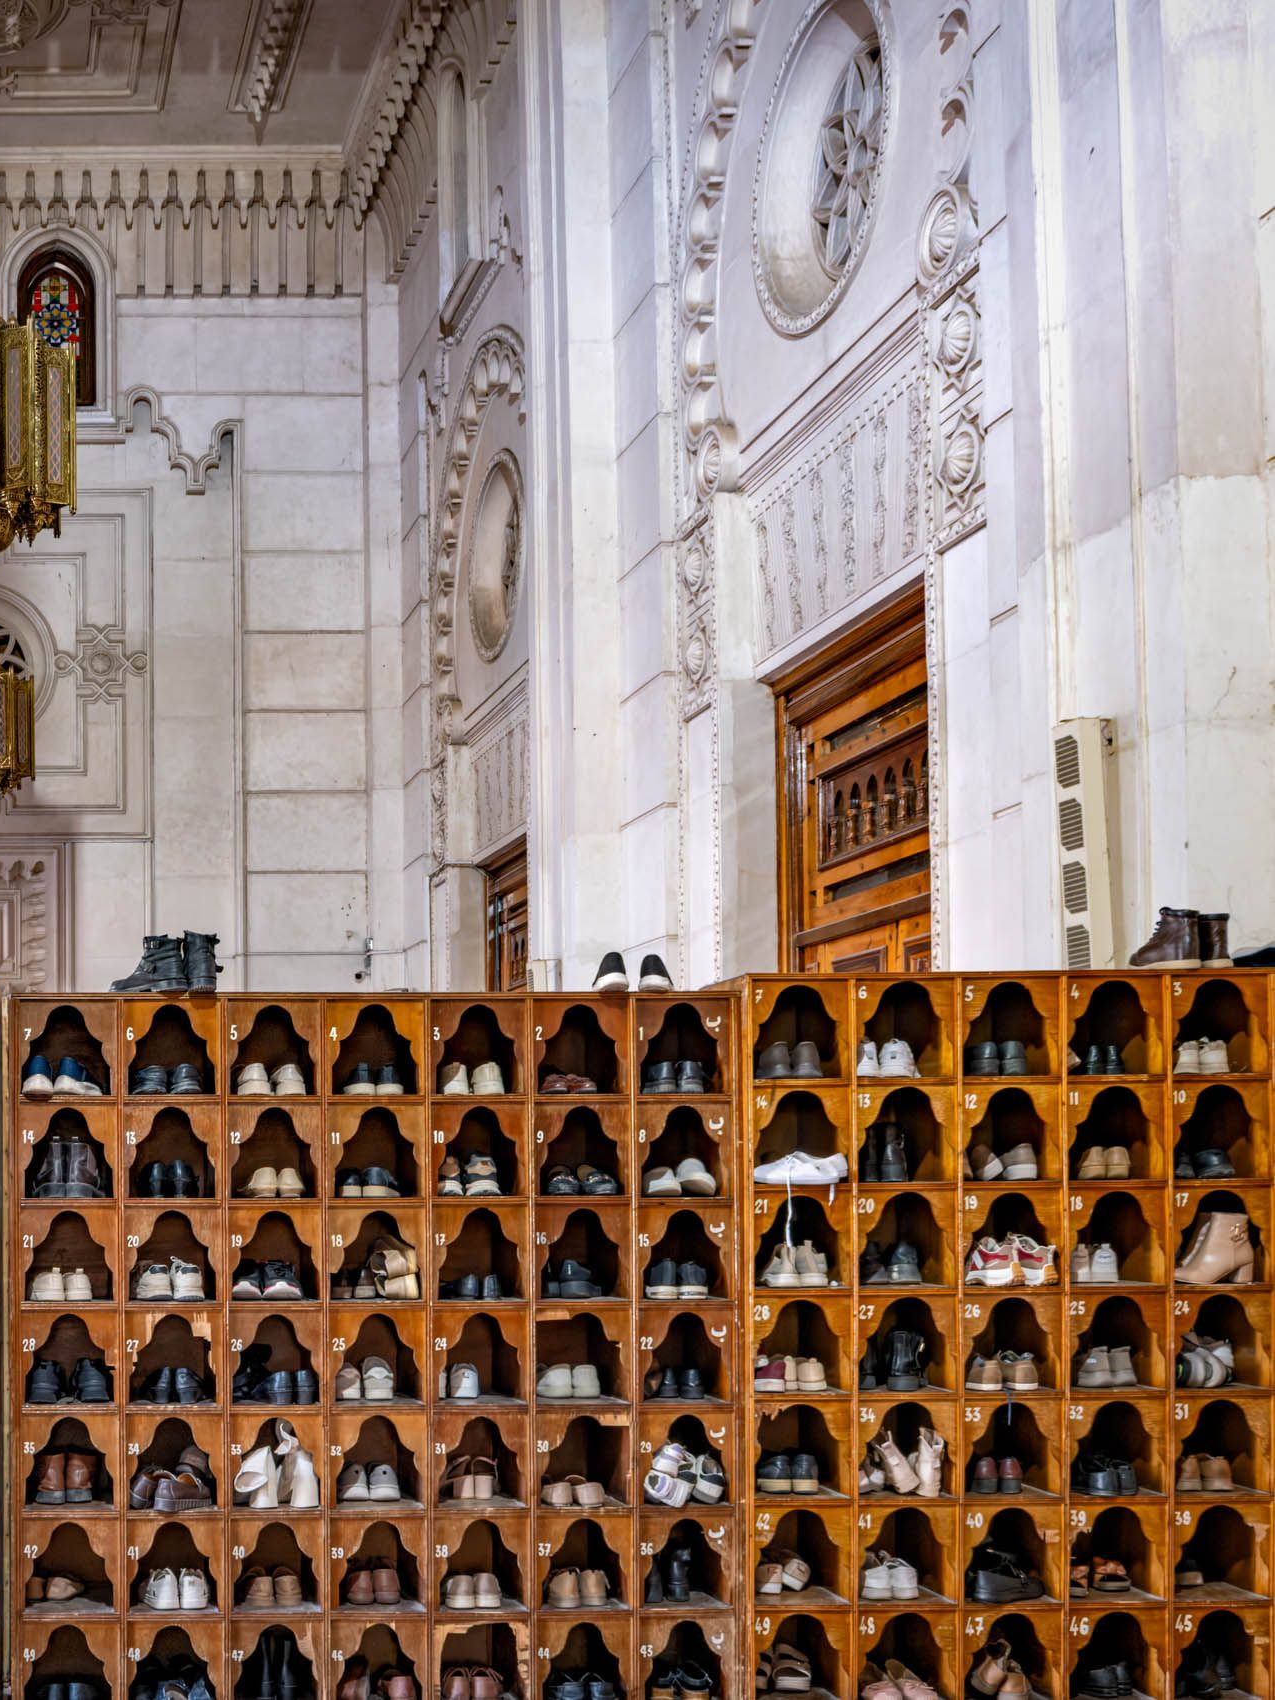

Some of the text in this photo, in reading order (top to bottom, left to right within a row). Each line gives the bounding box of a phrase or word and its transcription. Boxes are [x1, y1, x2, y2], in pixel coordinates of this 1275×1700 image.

[857, 985, 868, 1000] 6
[963, 984, 975, 1002] 5
[1069, 983, 1080, 1000] 4
[1172, 981, 1183, 996] 3
[705, 1015, 722, 1033] ب
[23, 1027, 32, 1041] 7
[126, 1026, 135, 1041] 6
[229, 1024, 238, 1041] 5
[329, 1026, 338, 1042] 4
[433, 1026, 441, 1041] 3
[535, 1025, 543, 1041] 2
[638, 1026, 644, 1041] 1
[756, 1095, 769, 1110] 14
[857, 1093, 871, 1108] 13
[964, 1093, 978, 1110] 12
[1069, 1091, 1079, 1106] 11
[1173, 1089, 1187, 1105] 10
[708, 1116, 725, 1136] ب
[22, 1129, 35, 1144] 14
[125, 1131, 137, 1145] 13
[230, 1131, 241, 1145] 12
[331, 1131, 340, 1145] 11
[433, 1130, 445, 1144] 10
[536, 1130, 544, 1144] 9
[638, 1128, 646, 1143] 8
[754, 1198, 768, 1214] 21
[857, 1197, 875, 1214] 20
[964, 1195, 978, 1210] 19
[1069, 1195, 1084, 1212] 18
[1175, 1192, 1190, 1208] 17
[709, 1221, 726, 1238] ب
[22, 1234, 34, 1249] 21
[126, 1234, 140, 1248] 20
[231, 1234, 243, 1248] 19
[331, 1234, 344, 1248] 18
[433, 1234, 445, 1247] 17
[638, 1233, 650, 1248] 15
[753, 1304, 771, 1320] 28
[859, 1304, 875, 1320] 27
[964, 1303, 981, 1319] 26
[1069, 1302, 1086, 1316] 25
[1174, 1300, 1190, 1316] 24
[710, 1325, 727, 1343] ب
[22, 1337, 36, 1353] 28
[126, 1339, 140, 1353] 27
[230, 1338, 243, 1352] 26
[332, 1337, 346, 1352] 25
[434, 1337, 448, 1351] 24
[640, 1336, 654, 1350] 22
[860, 1407, 876, 1423] 34
[964, 1406, 982, 1423] 33
[1174, 1402, 1189, 1420] 31
[709, 1426, 726, 1445] ب
[23, 1441, 36, 1455] 35
[230, 1444, 242, 1456] 33
[330, 1445, 342, 1457] 32
[433, 1442, 446, 1455] 31
[536, 1439, 550, 1453] 30
[640, 1440, 652, 1453] 29
[857, 1513, 872, 1529] 41
[966, 1512, 984, 1529] 40
[1070, 1509, 1087, 1527] 39
[708, 1525, 726, 1545] ب
[23, 1544, 39, 1559] 42
[127, 1545, 139, 1561] 41
[232, 1545, 246, 1560] 40
[331, 1547, 344, 1559] 39
[435, 1544, 449, 1558] 38
[538, 1542, 552, 1557] 37
[640, 1542, 654, 1556] 36
[965, 1616, 985, 1636] 47
[1069, 1616, 1090, 1636] 46
[1175, 1614, 1193, 1633] 45
[711, 1632, 725, 1650] ب
[127, 1647, 141, 1662] 48
[639, 1644, 654, 1658] 43
